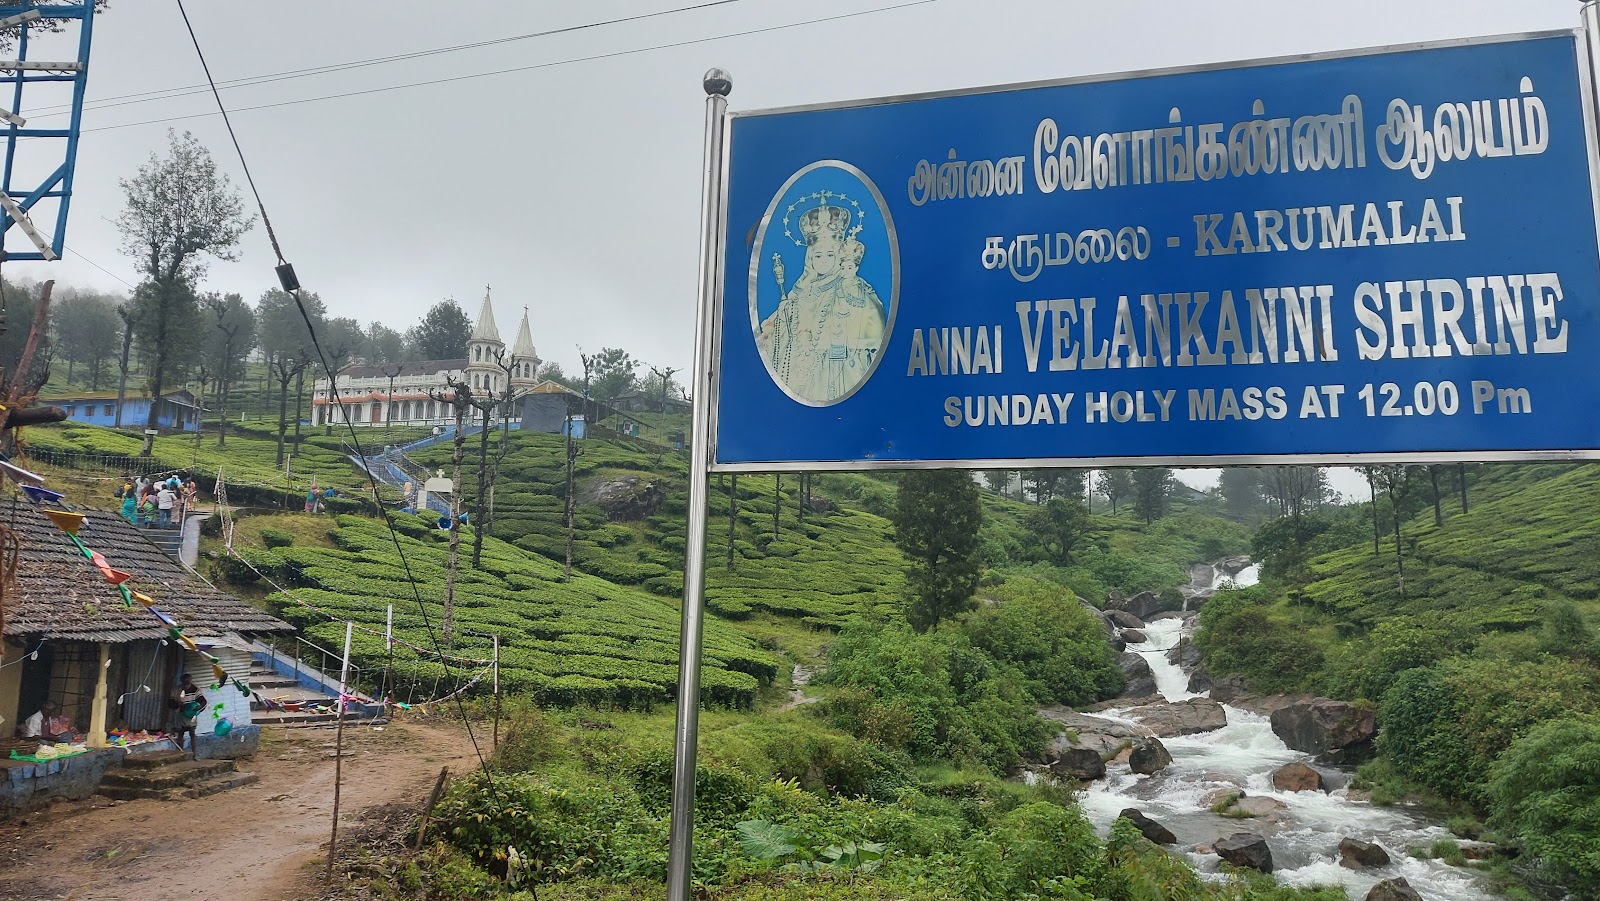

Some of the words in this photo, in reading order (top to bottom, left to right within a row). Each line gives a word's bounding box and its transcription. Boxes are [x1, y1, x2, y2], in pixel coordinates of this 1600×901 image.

[908, 148, 1026, 206] அன்னை
[1033, 93, 1367, 194] வேளாங்கண்ணி
[1376, 75, 1550, 180] ஆலயம்
[981, 226, 1151, 283] கருமலை
[1167, 236, 1180, 248] -
[1193, 196, 1467, 257] KARUMALAI
[907, 325, 1003, 378] ANNAI
[1015, 284, 1339, 374] VELANKANNI
[1353, 272, 1569, 362] SHRINE
[943, 391, 1075, 427] SUNDAY
[1085, 389, 1176, 424] HOLY
[1188, 386, 1288, 421] MASS
[1300, 384, 1345, 420] AT
[1357, 380, 1460, 418] 12.00
[1471, 380, 1532, 415] Pm
